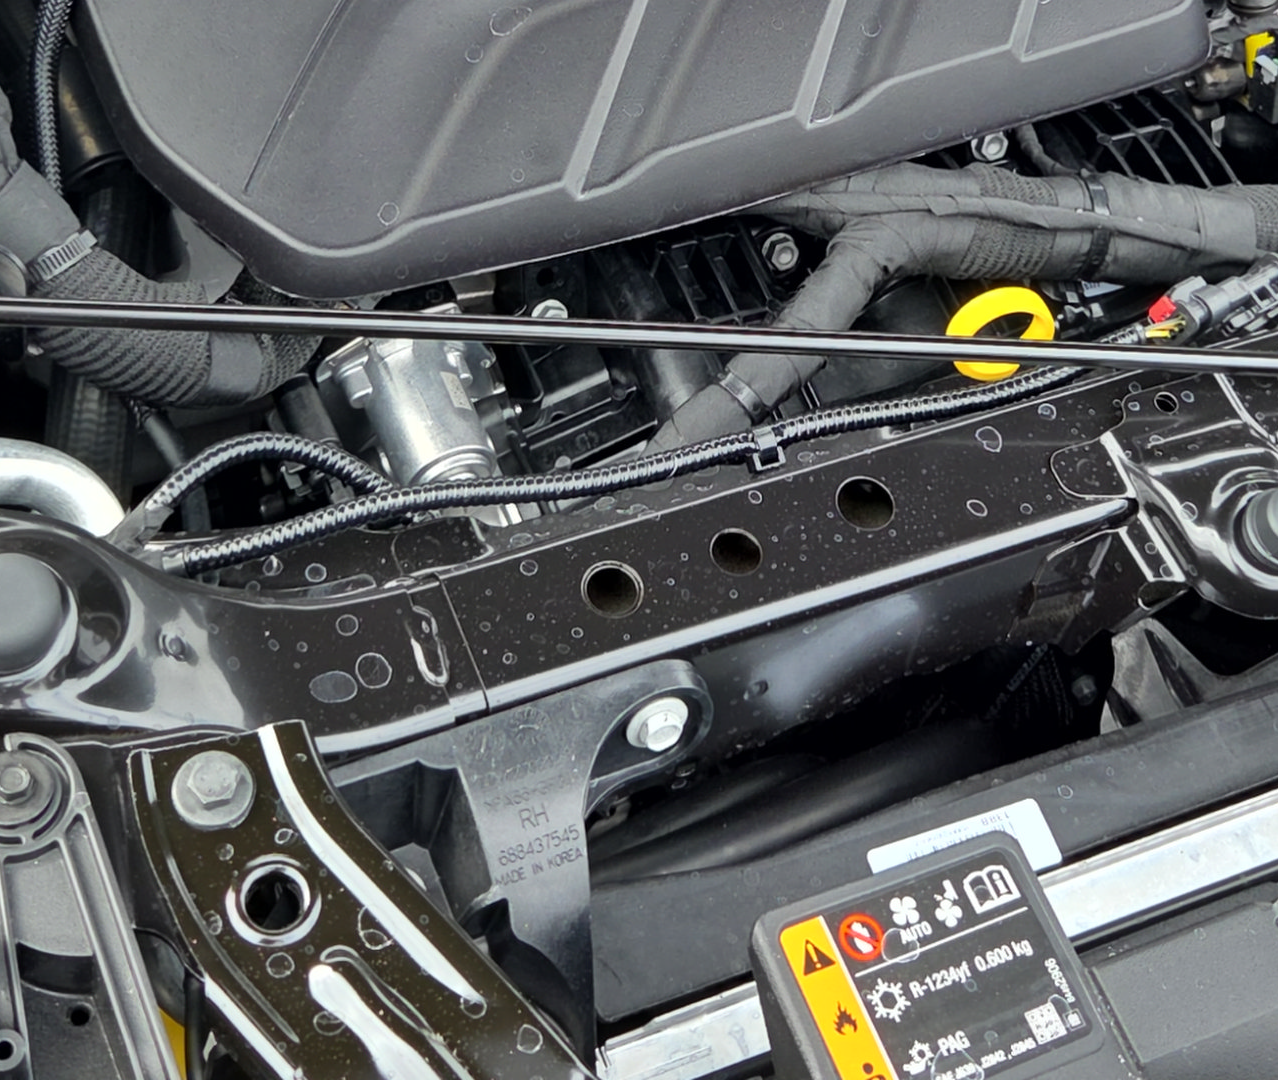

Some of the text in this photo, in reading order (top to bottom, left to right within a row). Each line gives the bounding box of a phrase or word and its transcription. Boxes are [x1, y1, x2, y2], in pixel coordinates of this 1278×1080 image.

[518, 803, 550, 830] RH
[494, 847, 585, 886] MADE IN KOREA
[899, 922, 933, 945] AUTO
[908, 937, 1034, 999] R-1234yf 0.600 kg
[936, 1030, 971, 1057] PAG
